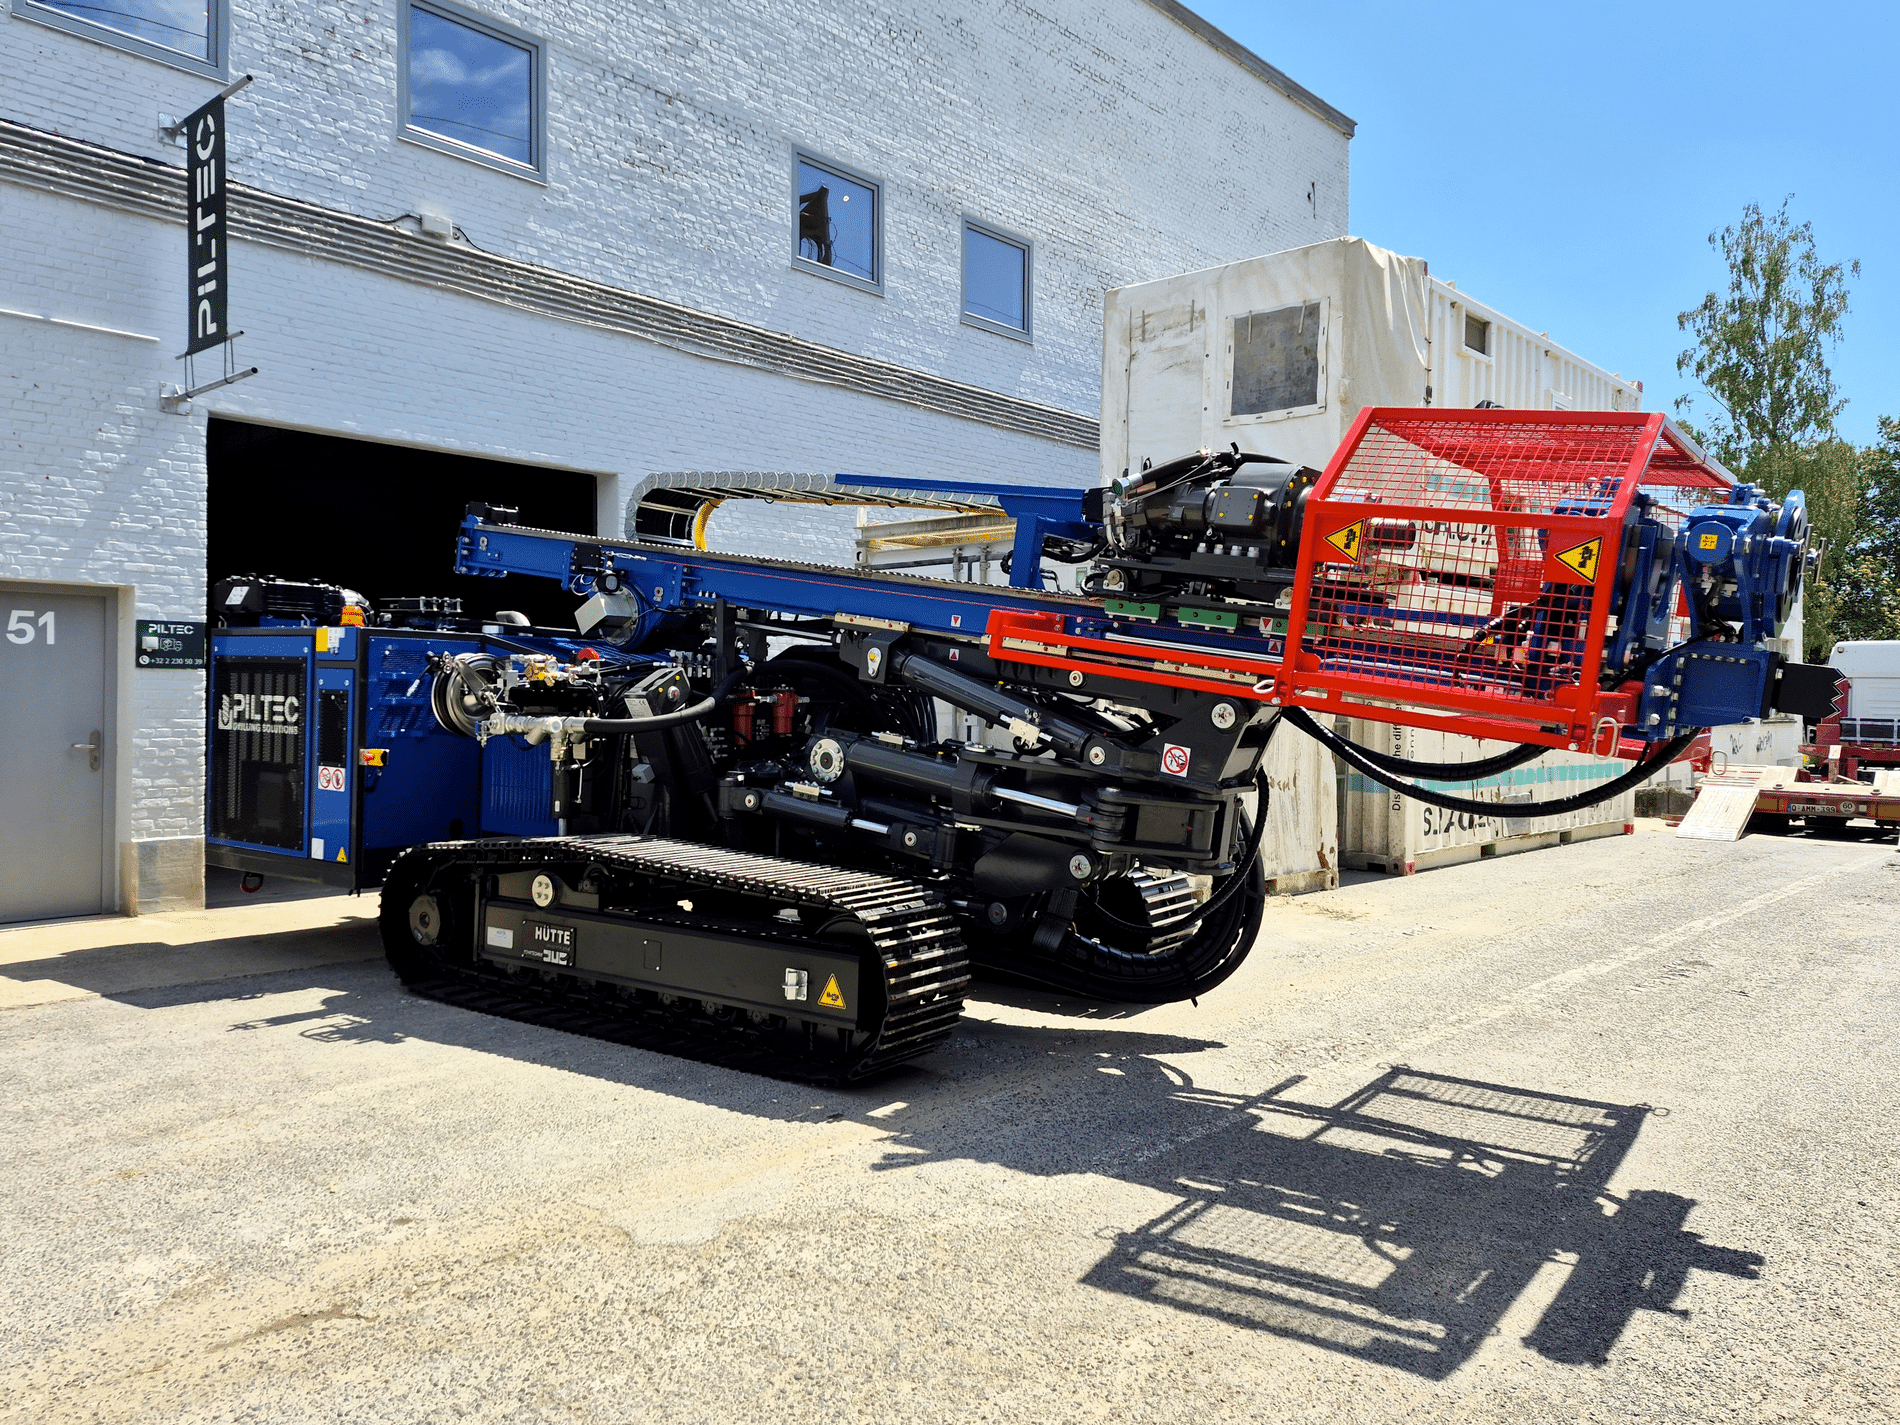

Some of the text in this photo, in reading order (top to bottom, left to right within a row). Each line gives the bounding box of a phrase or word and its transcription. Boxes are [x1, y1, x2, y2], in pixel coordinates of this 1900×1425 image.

[196, 113, 217, 338] PILTEC
[6, 609, 55, 645] 51
[149, 624, 194, 634] PILTEC
[233, 693, 299, 723] PILTEC
[262, 723, 299, 735] SOLUTIONS
[1392, 743, 1402, 758] he
[535, 925, 570, 945] HÜTTE
